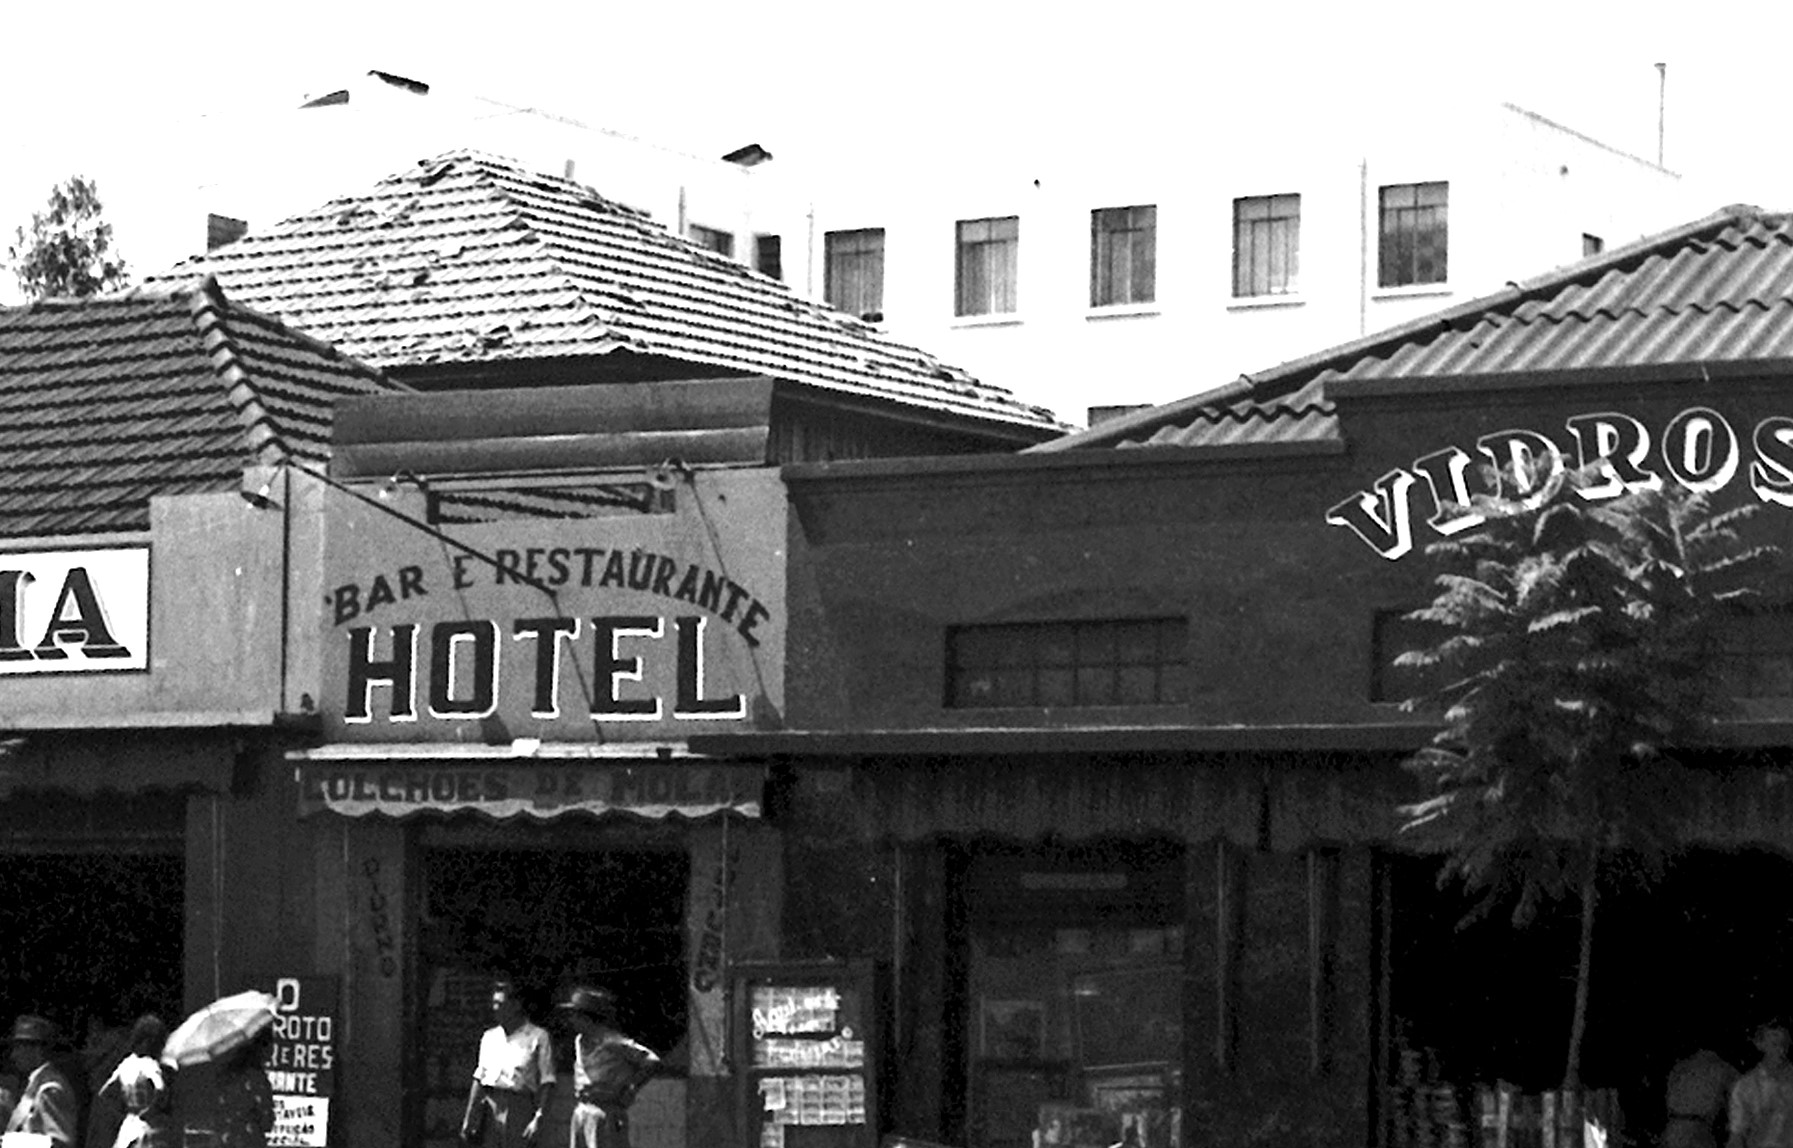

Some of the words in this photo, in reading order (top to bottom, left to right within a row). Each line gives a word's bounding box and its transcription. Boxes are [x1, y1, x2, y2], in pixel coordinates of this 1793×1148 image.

[1324, 407, 1793, 561] VIDROS
[333, 565, 428, 627] BAR
[453, 554, 475, 590] E
[495, 547, 770, 647] RESTAURANTE
[343, 615, 746, 724] HOTEL
